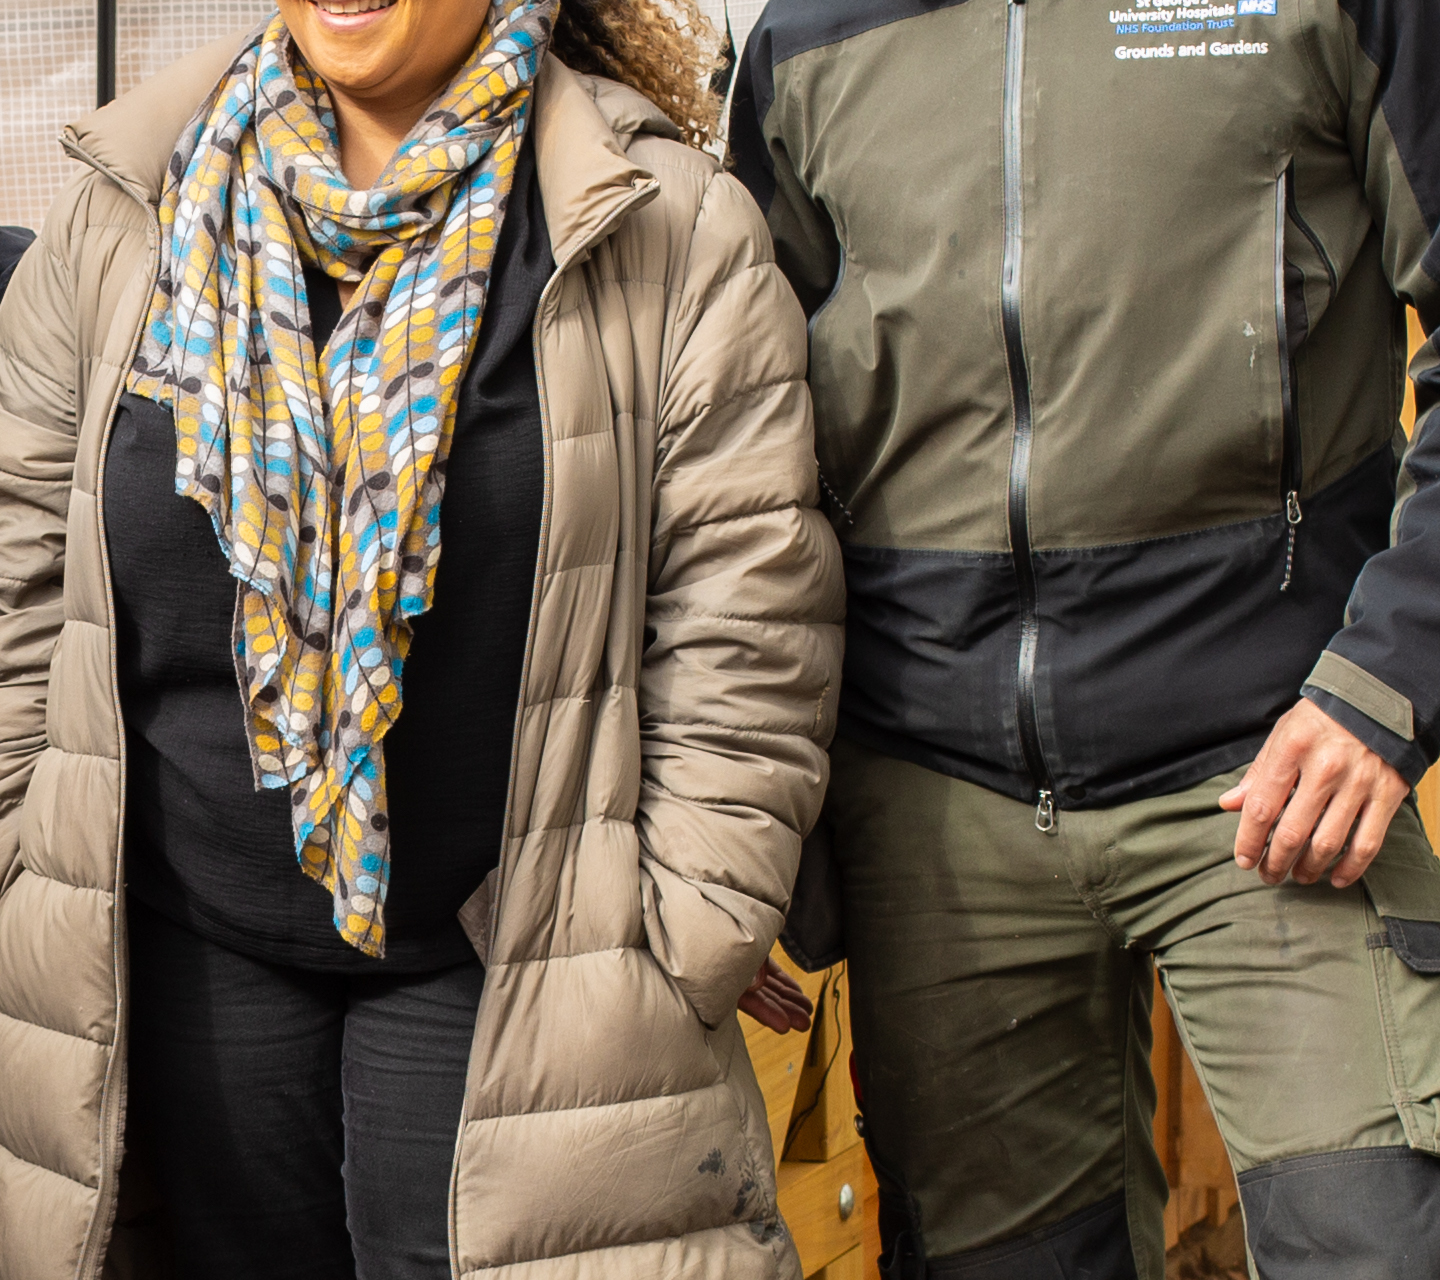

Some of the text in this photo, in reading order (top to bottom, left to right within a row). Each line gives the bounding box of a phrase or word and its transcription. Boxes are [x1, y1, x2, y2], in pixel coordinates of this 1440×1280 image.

[1109, 3, 1235, 23] University Hospitals
[1239, 0, 1274, 14] NHS
[1116, 18, 1235, 35] NHS Foundation Trust
[1114, 39, 1269, 60] Grounds and Gardens
